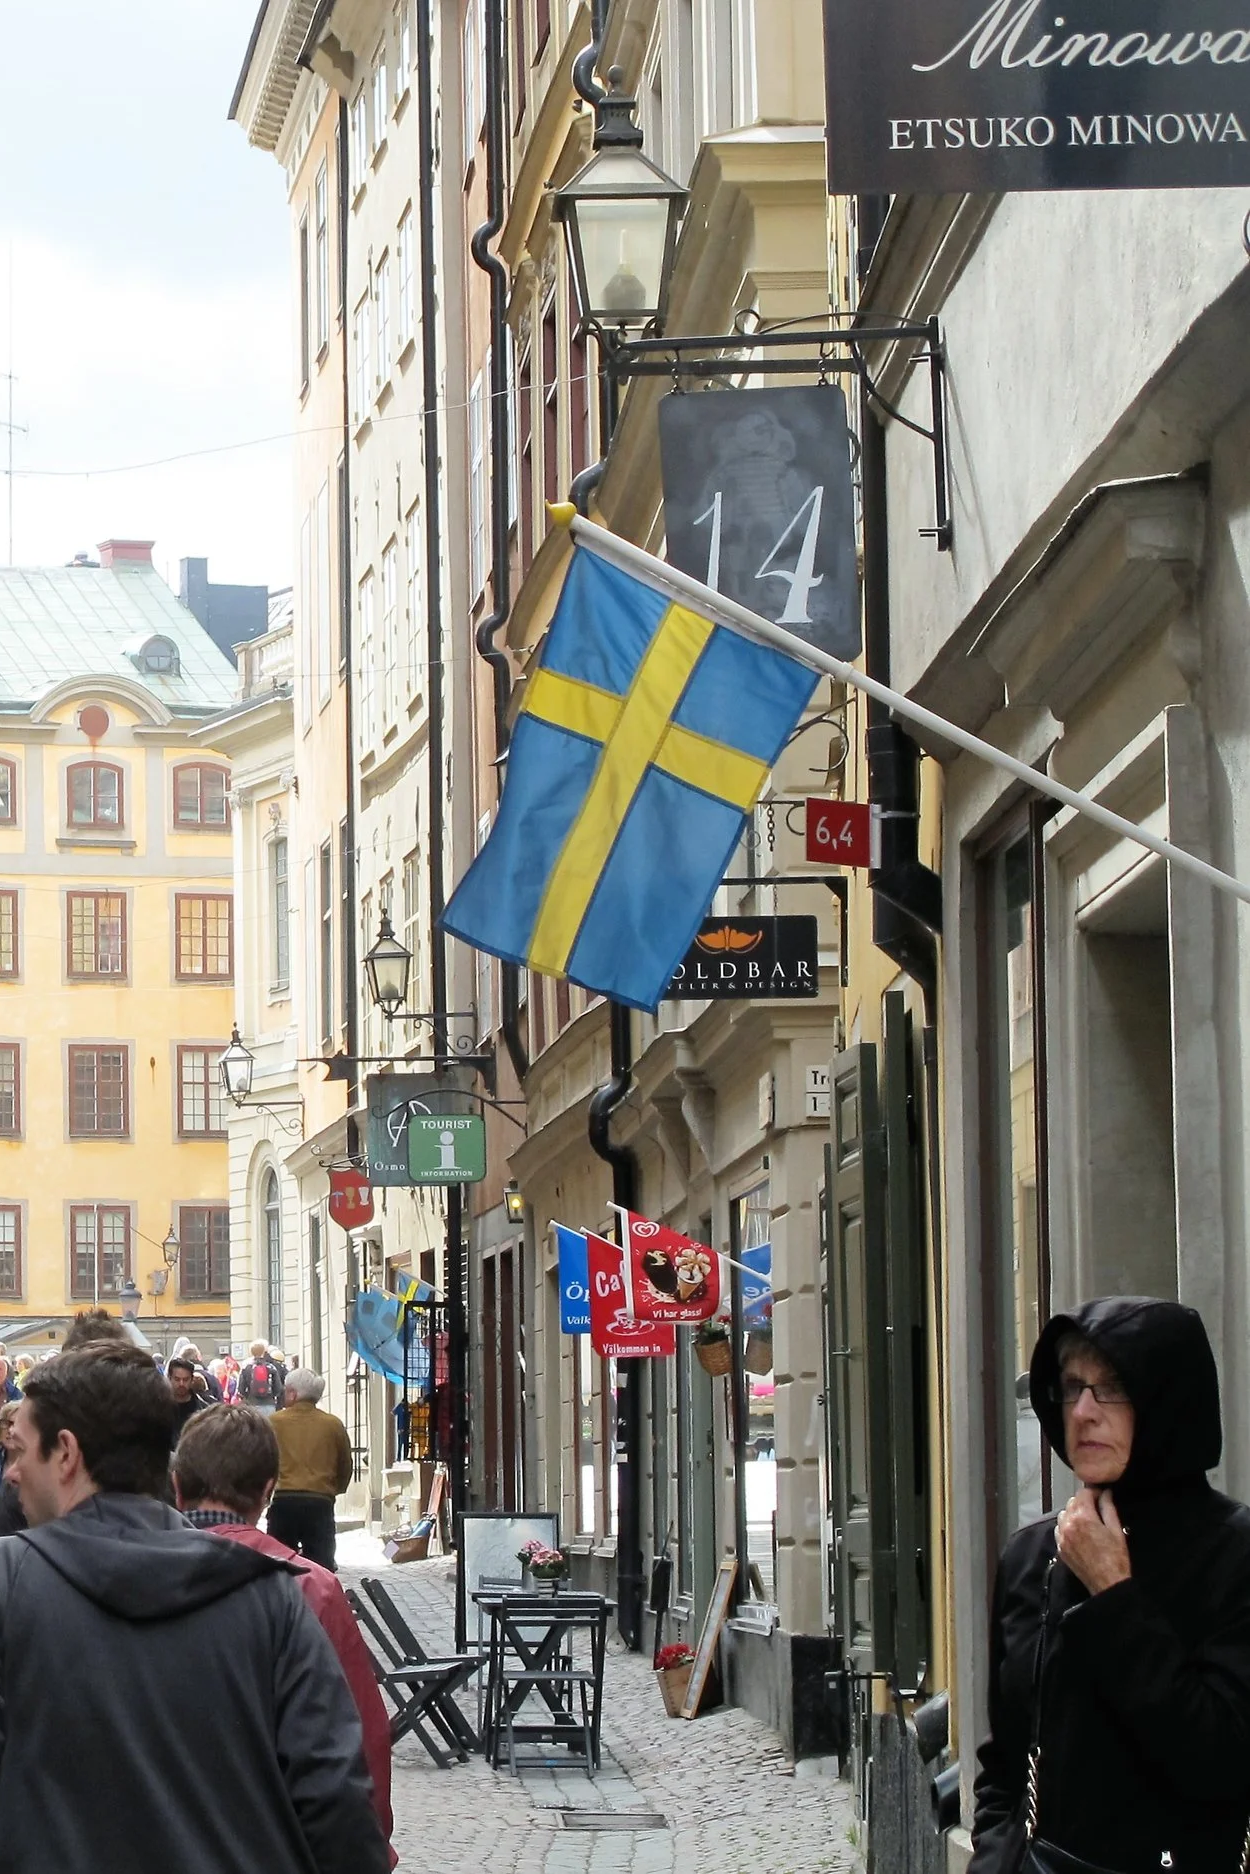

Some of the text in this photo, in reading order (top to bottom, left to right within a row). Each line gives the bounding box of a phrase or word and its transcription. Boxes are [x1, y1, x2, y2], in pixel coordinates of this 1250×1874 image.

[911, 0, 1250, 72] Minowa
[888, 112, 1248, 150] ETSUKO MINOWA
[693, 485, 825, 624] 14
[815, 815, 853, 851] 6,4
[728, 981, 737, 989] &
[745, 980, 812, 989] DESIGN
[812, 1096, 830, 1112] 1-
[421, 1120, 472, 1130] TOURIST
[374, 1161, 406, 1171] Osmo
[595, 1261, 625, 1297] Ca
[653, 1307, 702, 1319] Vi har glass!
[602, 1343, 661, 1354] Välkommen in
